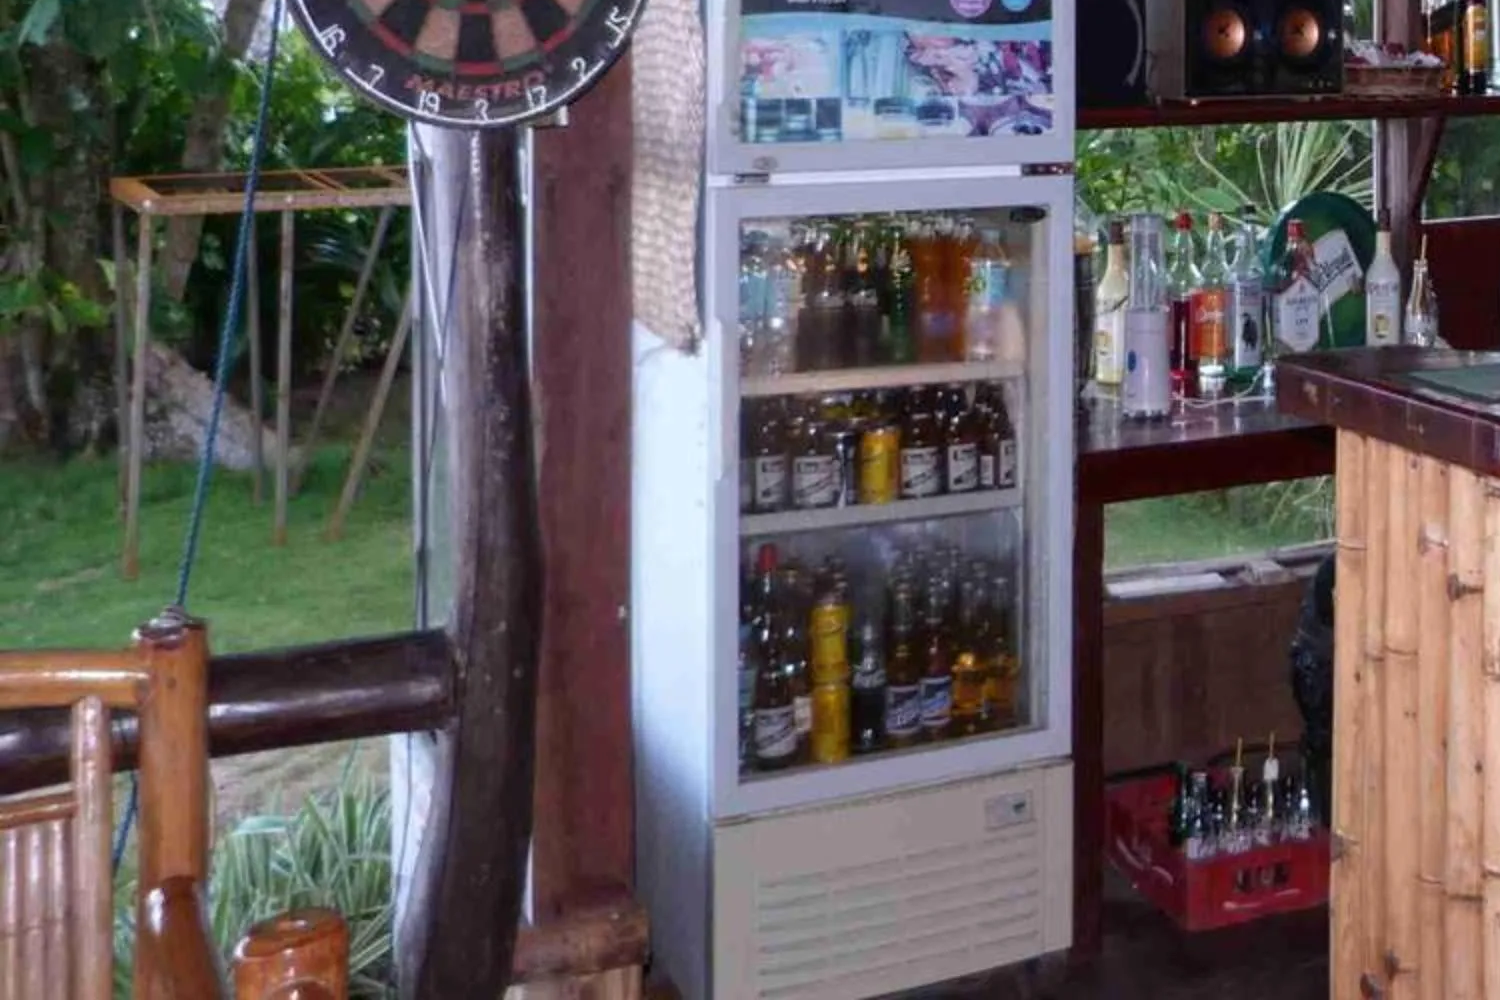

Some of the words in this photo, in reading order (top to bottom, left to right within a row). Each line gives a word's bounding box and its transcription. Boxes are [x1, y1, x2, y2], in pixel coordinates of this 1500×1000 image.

[604, 6, 631, 36] 15
[318, 23, 347, 49] 16
[369, 63, 385, 90] 7
[570, 56, 588, 81] 2
[403, 69, 546, 102] MAESTRO
[525, 84, 547, 111] 17
[418, 89, 442, 117] 19
